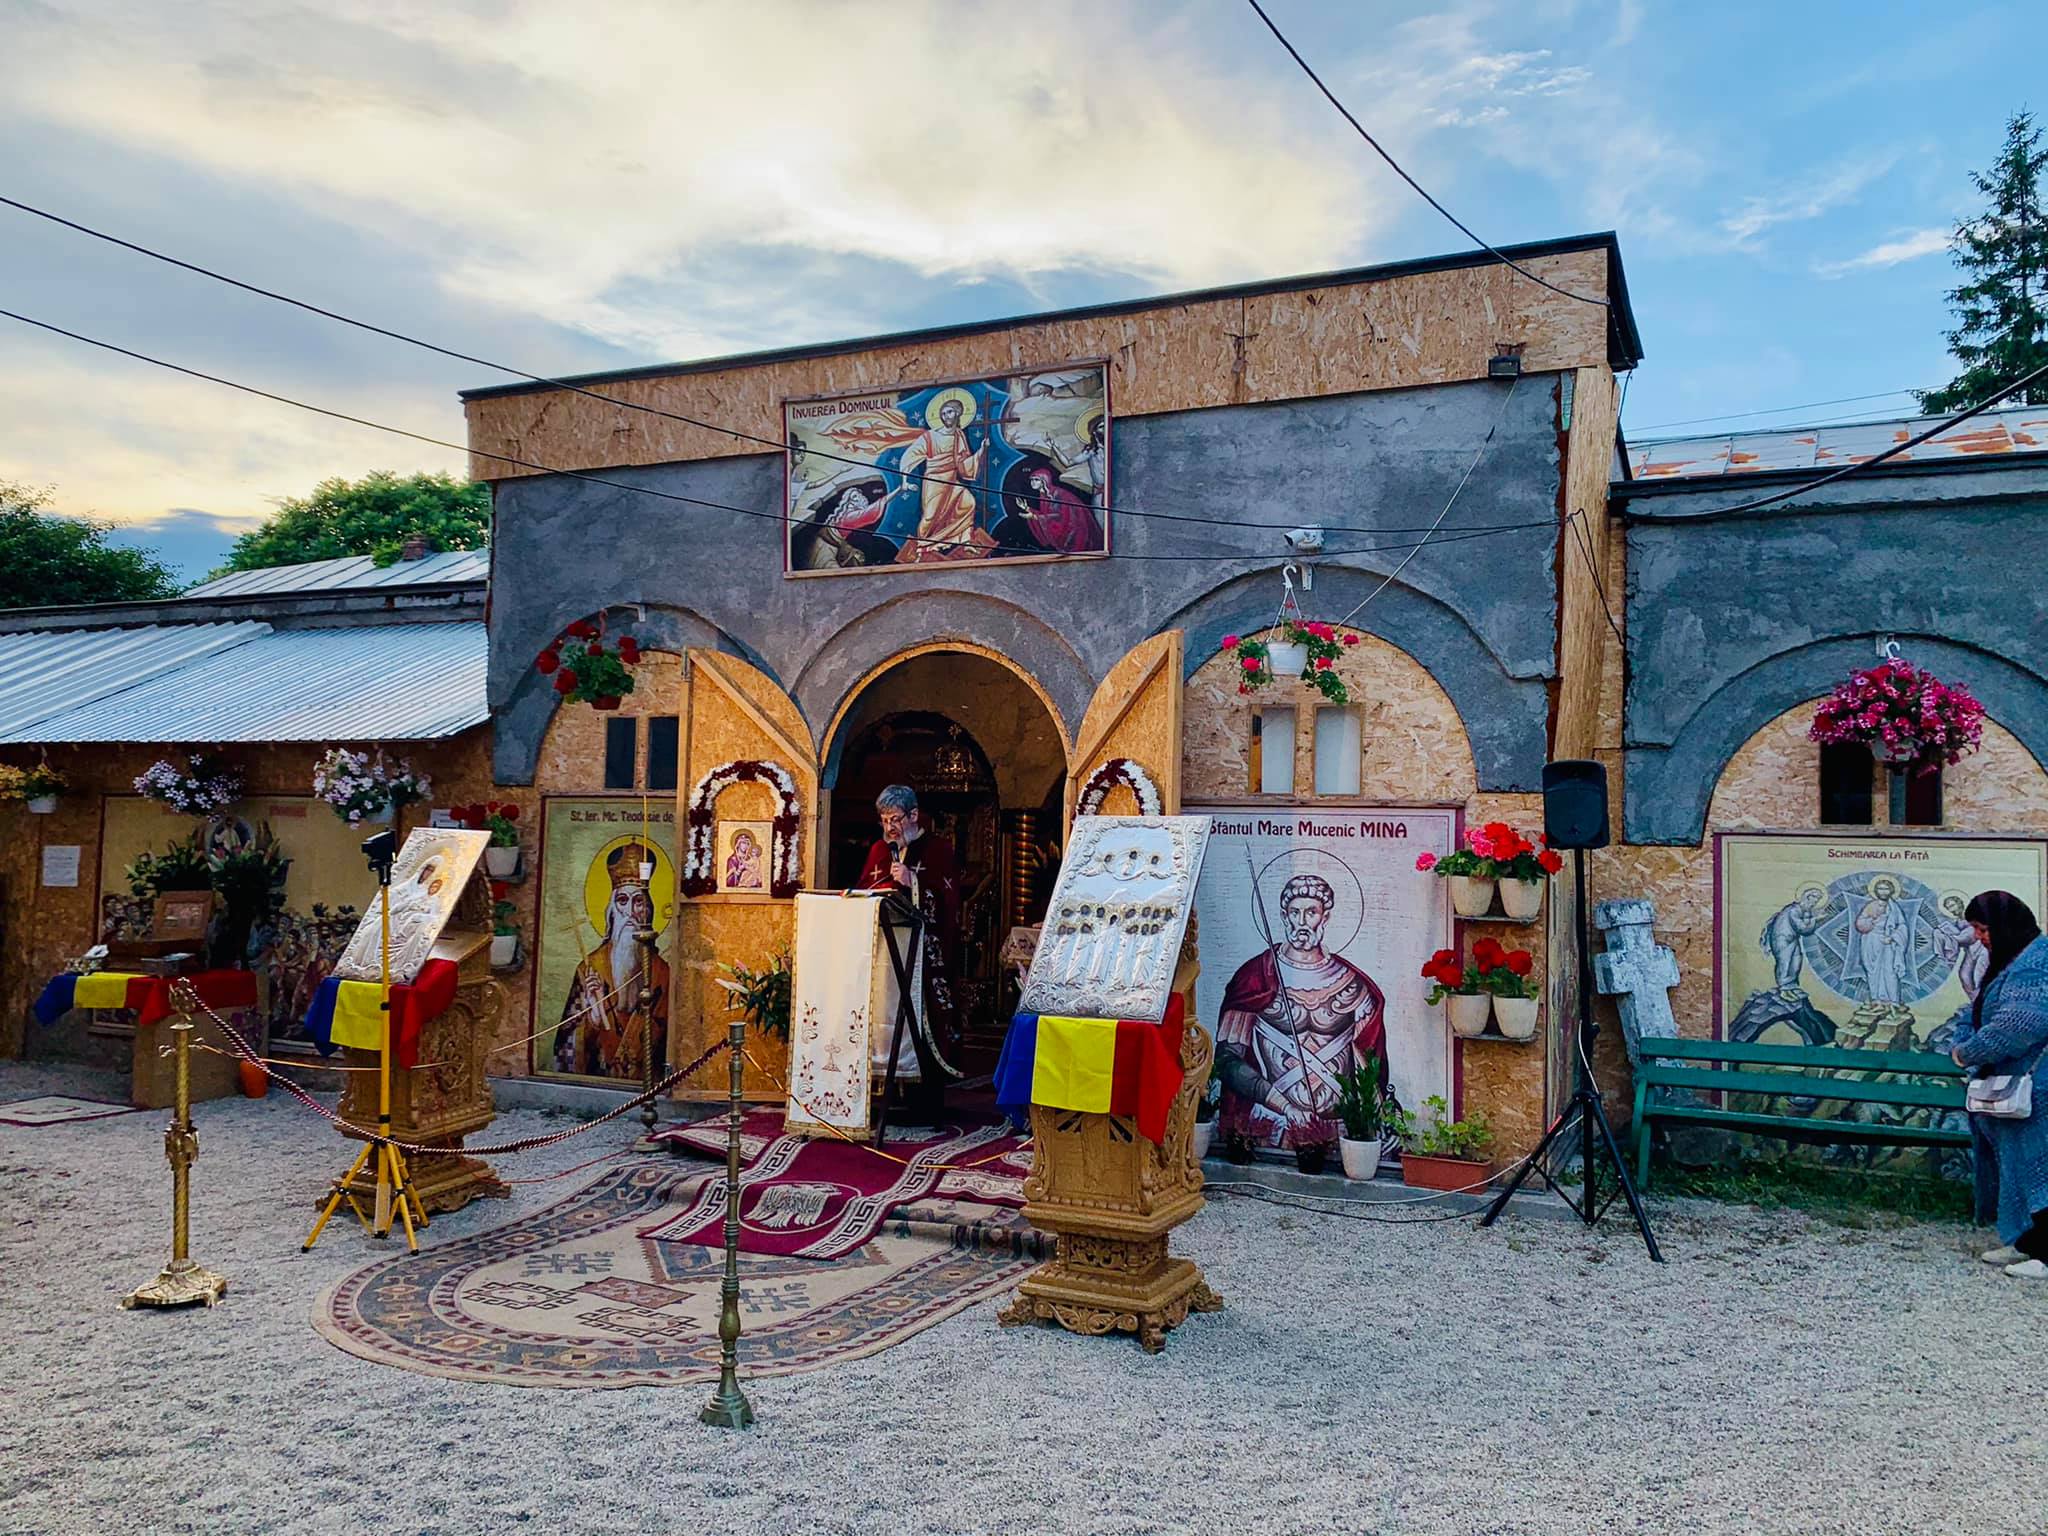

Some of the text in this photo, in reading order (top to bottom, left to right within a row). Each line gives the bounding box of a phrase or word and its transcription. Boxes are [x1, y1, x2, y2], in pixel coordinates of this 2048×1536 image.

[839, 398, 890, 414] DOMNULUI
[663, 811, 674, 822] de
[1257, 820, 1293, 836] Mare
[1298, 821, 1356, 837] Mucenic
[1360, 822, 1407, 838] MINA
